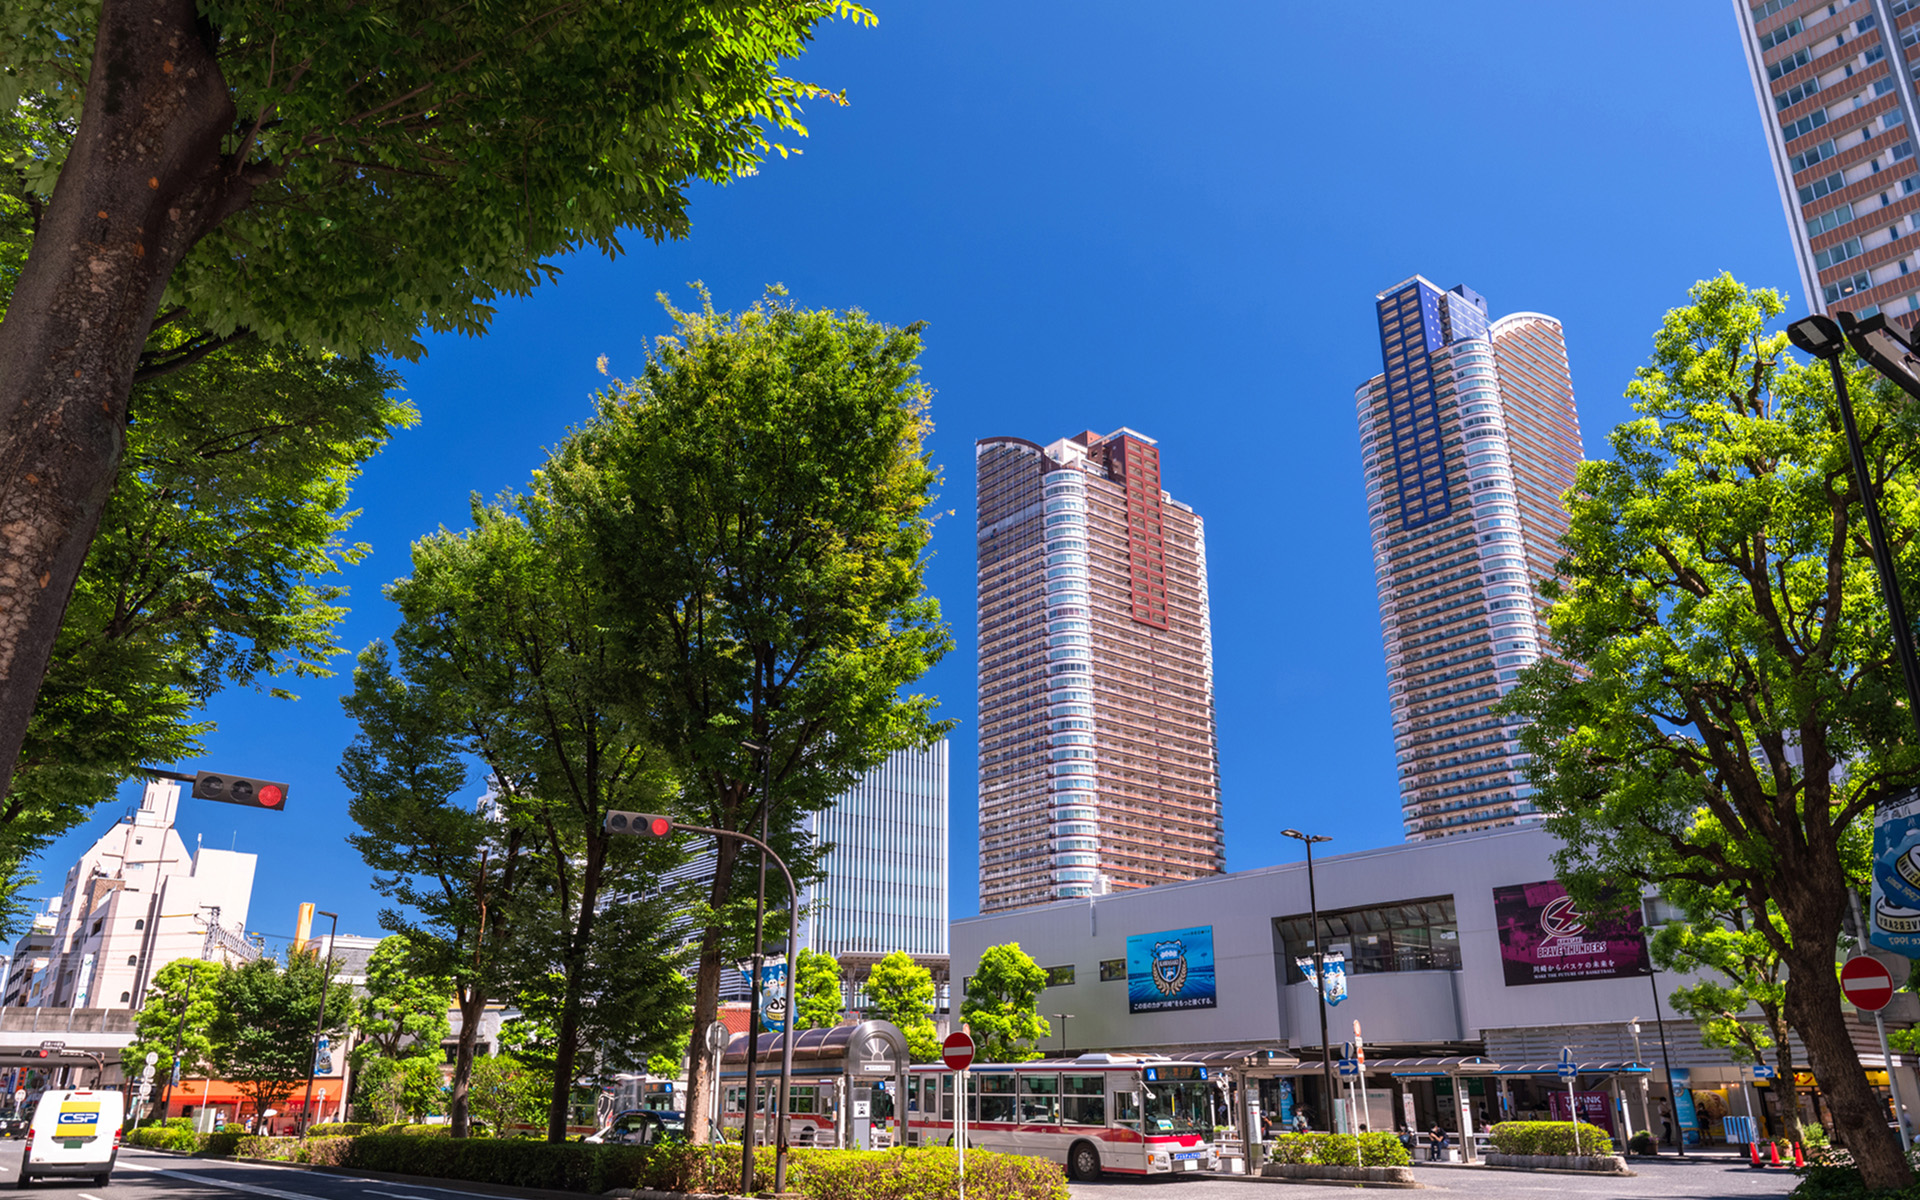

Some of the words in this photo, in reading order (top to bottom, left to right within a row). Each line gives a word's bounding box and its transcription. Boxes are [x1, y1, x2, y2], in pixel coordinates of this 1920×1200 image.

[1886, 876, 1902, 891] since
[1902, 886, 1920, 902] 1997
[1538, 946, 1563, 957] BRAVE
[1564, 942, 1606, 954] THUNDERS
[60, 1113, 97, 1123] CSP
